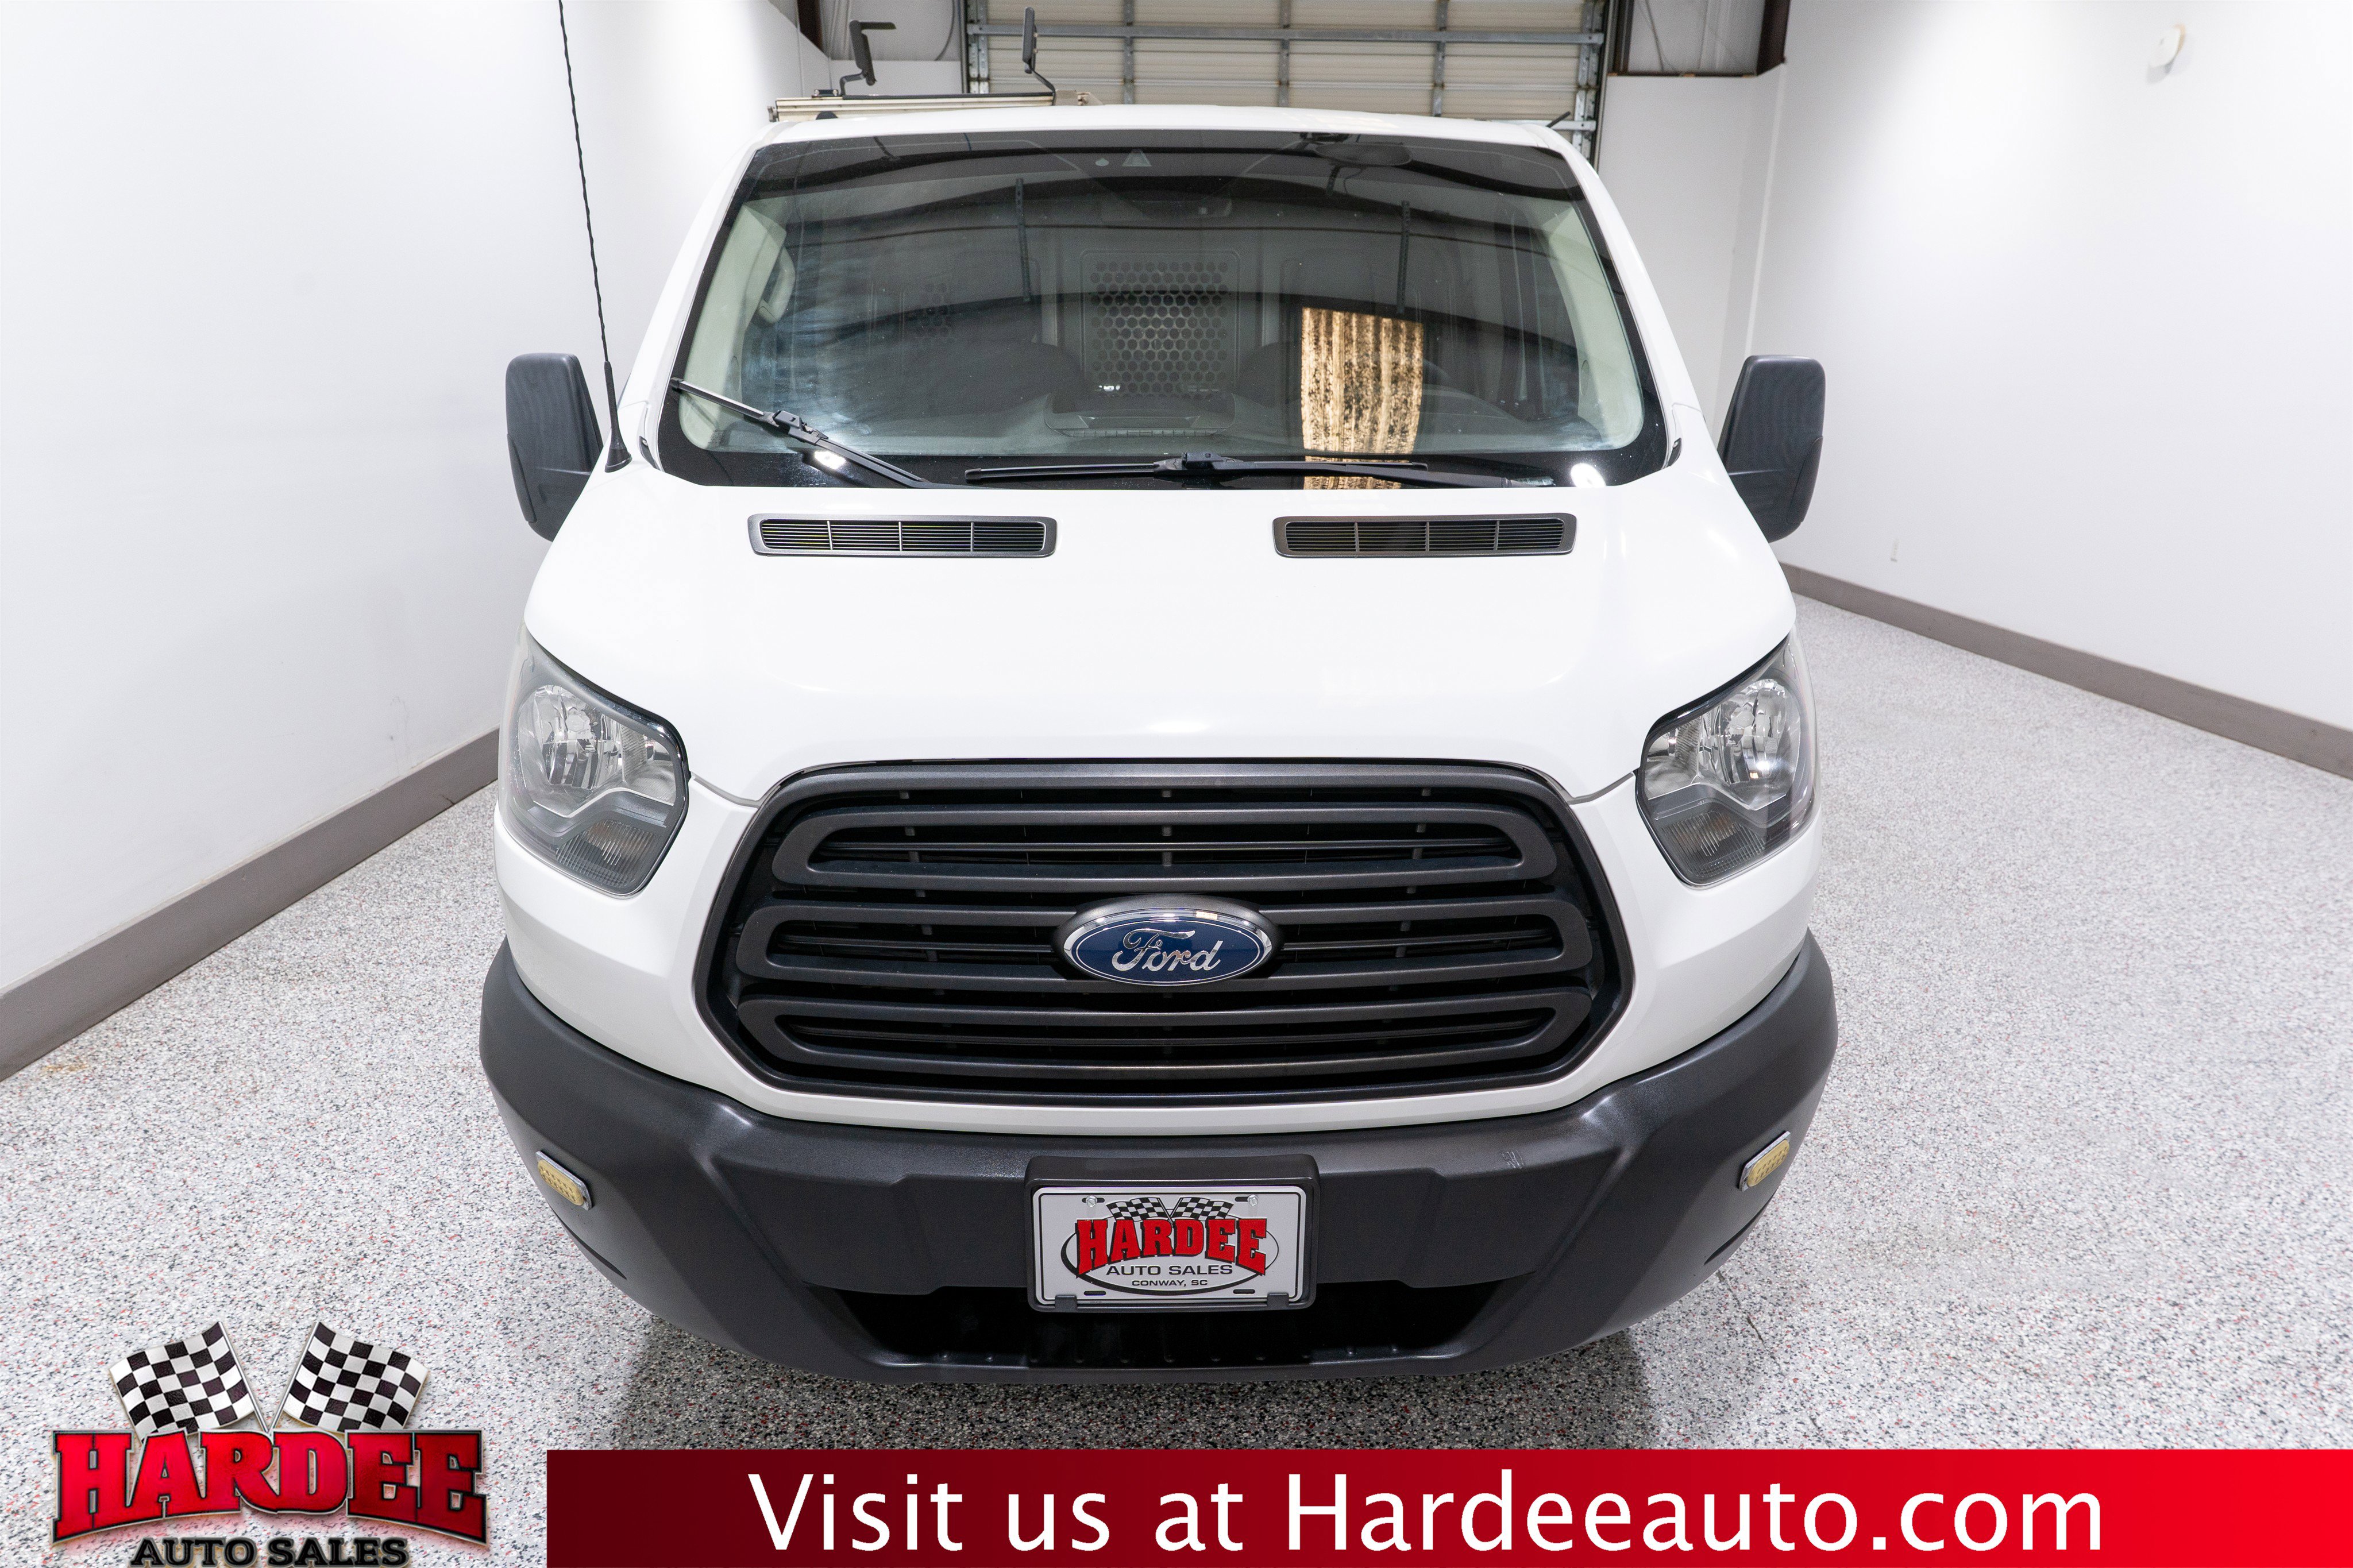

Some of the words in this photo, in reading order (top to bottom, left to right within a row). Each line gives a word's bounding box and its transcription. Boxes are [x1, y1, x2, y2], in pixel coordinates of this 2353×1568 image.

[1112, 928, 1224, 971] Ford
[1075, 1218, 1267, 1277] HARDEE
[1106, 1264, 1162, 1276] AUTO
[1168, 1264, 1233, 1276] SALES
